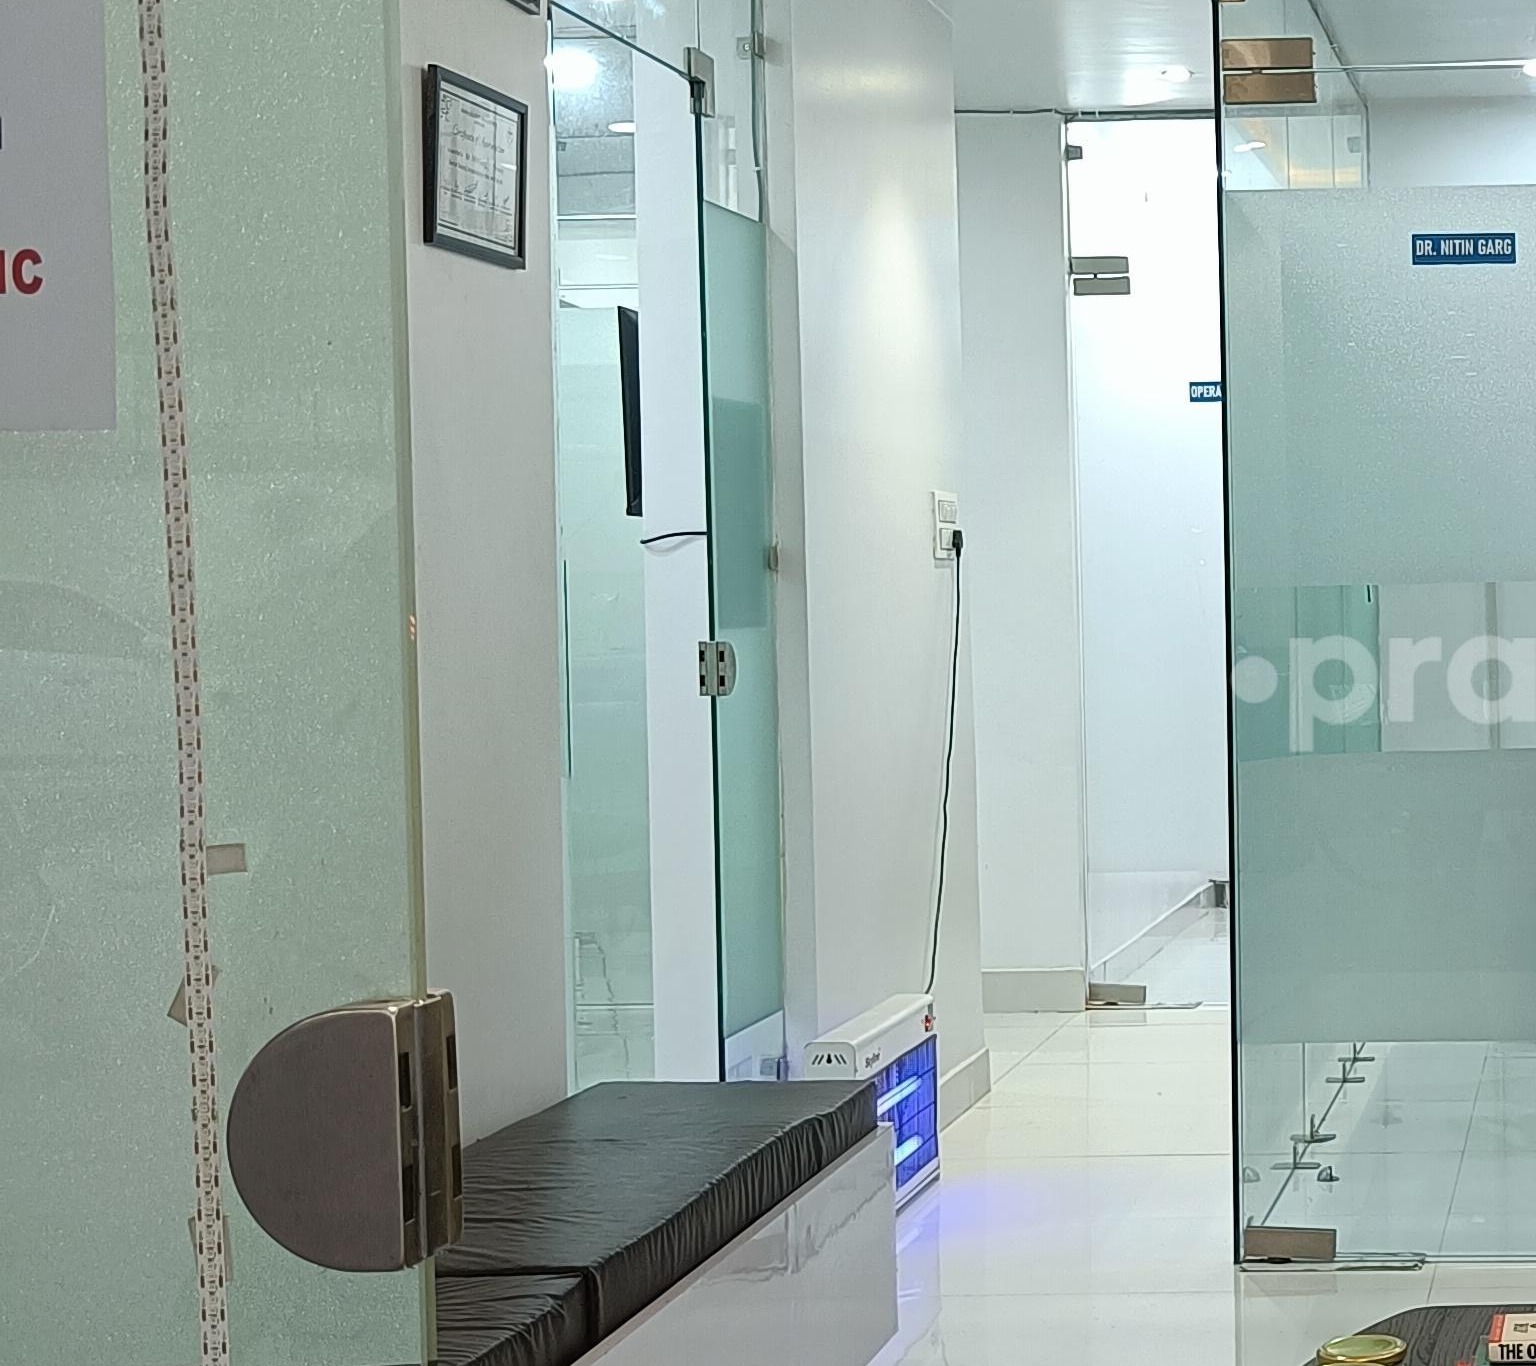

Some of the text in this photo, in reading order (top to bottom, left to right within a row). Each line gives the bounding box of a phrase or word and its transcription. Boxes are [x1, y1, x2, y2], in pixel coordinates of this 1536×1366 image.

[1416, 238, 1512, 256] DR. NITIN GARG
[1498, 1343, 1523, 1360] THE
